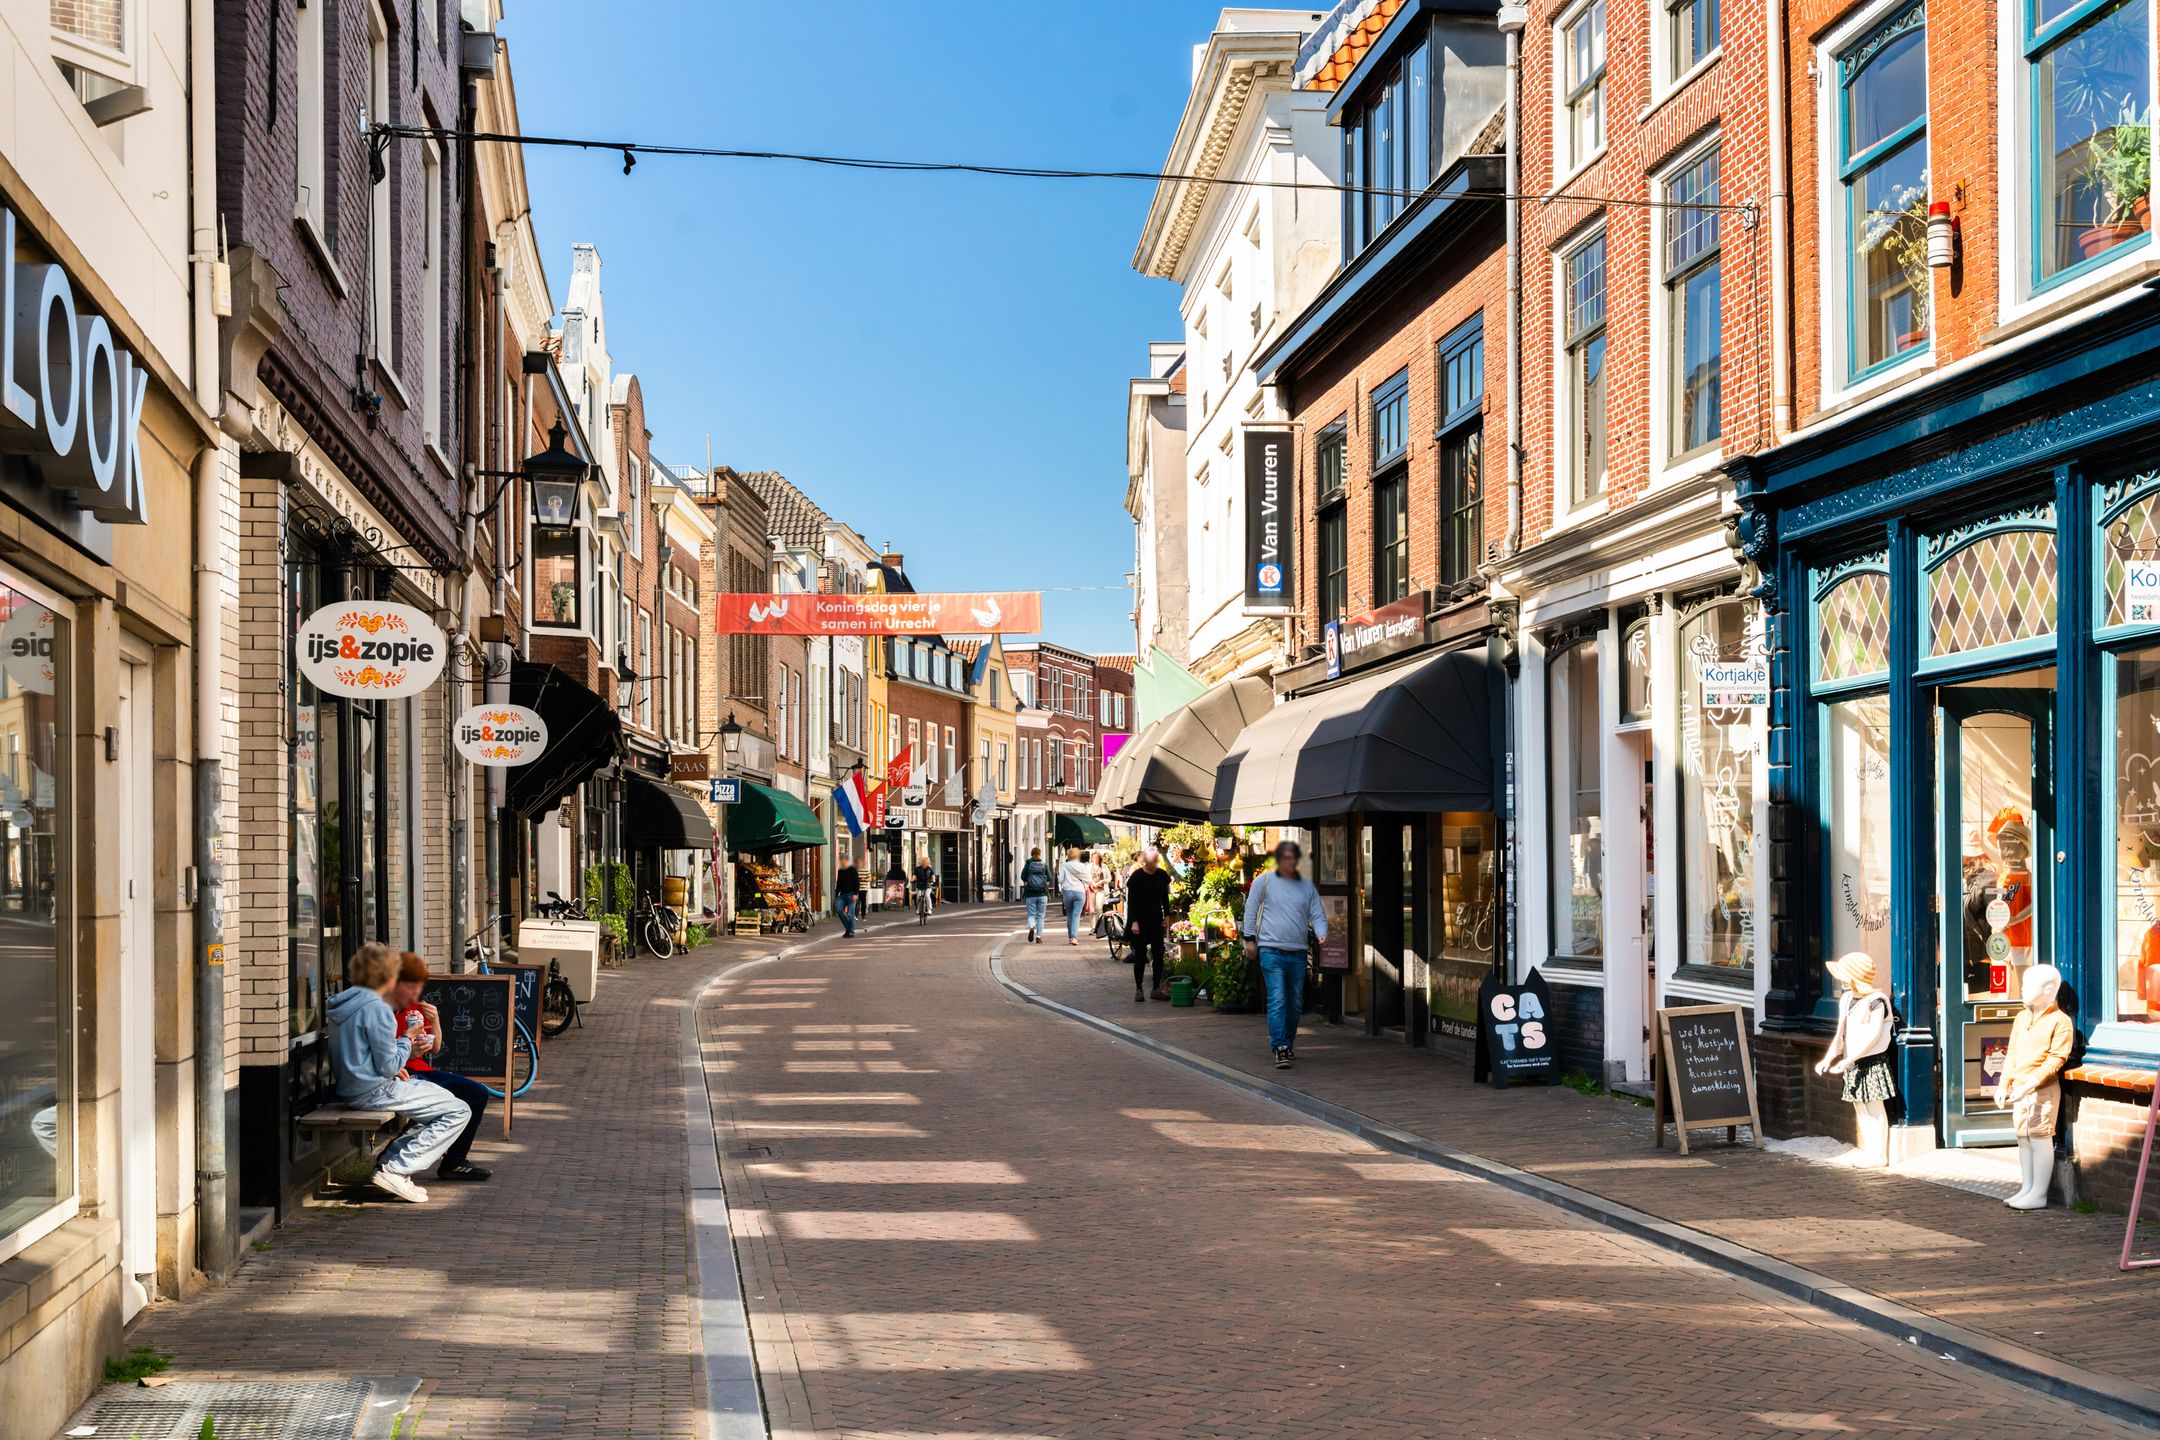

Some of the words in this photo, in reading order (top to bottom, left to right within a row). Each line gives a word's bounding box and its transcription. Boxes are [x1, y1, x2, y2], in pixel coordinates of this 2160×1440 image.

[4, 208, 148, 524] LOOK
[1261, 443, 1277, 516] Vuuren
[1261, 522, 1277, 560] Van
[816, 601, 897, 615] Koningsdag
[900, 601, 926, 612] vier
[928, 600, 941, 615] je
[821, 619, 865, 630] samen
[870, 617, 882, 629] in
[885, 617, 937, 630] Utrecht
[308, 633, 434, 667] ijs&zopie
[1340, 632, 1354, 655] Van
[1355, 623, 1383, 650] Vuuren
[1705, 668, 1766, 684] Kortjakje
[461, 725, 540, 745] ijs&zopie
[674, 761, 706, 773] KAAS
